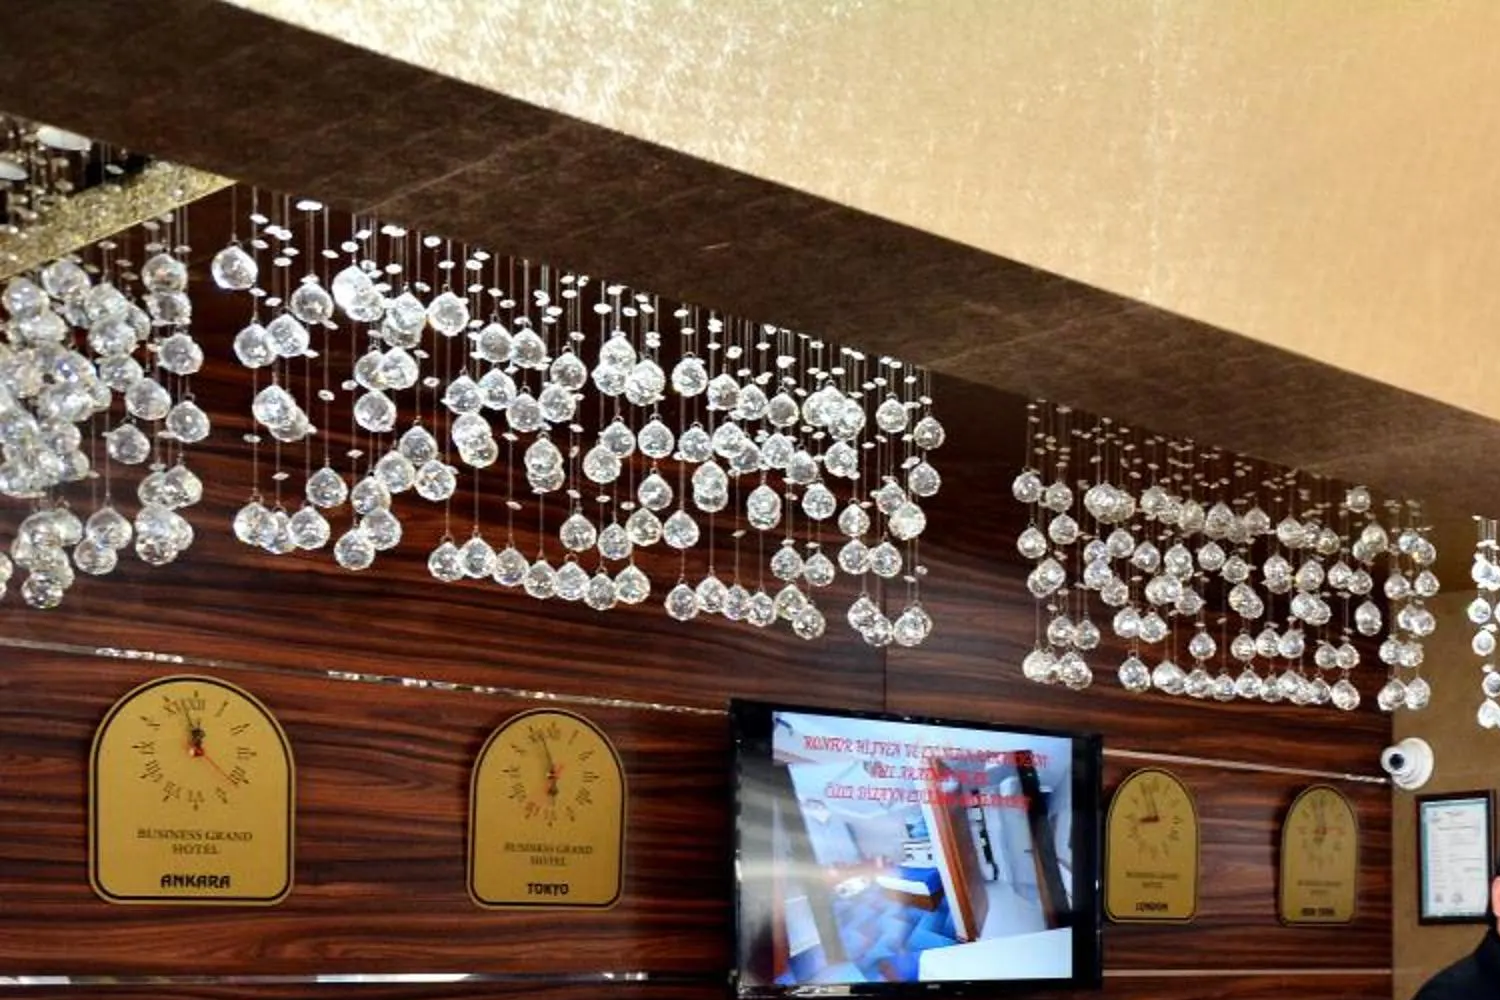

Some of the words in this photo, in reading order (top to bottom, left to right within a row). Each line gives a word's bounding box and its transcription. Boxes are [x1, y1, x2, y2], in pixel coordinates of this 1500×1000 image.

[136, 828, 202, 840] BUSINESS
[205, 830, 252, 842] GRAND
[172, 843, 219, 855] HOTEL
[160, 873, 231, 889] ANKARA
[527, 882, 570, 896] TOKYO
